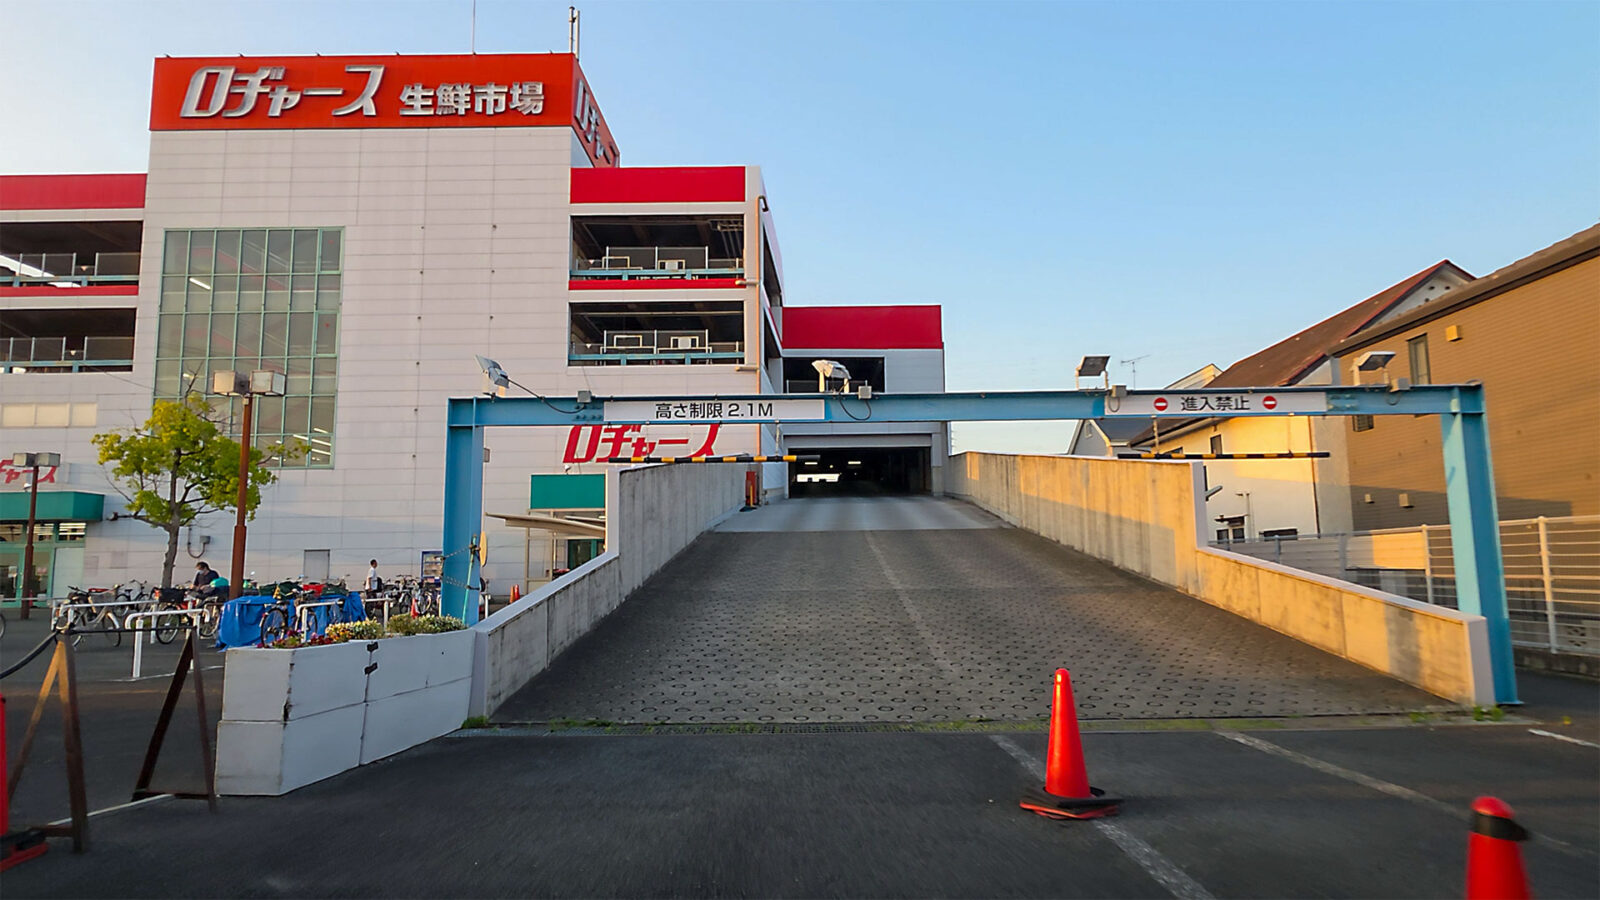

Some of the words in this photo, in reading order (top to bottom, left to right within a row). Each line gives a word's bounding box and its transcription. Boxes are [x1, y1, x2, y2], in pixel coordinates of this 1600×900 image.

[180, 65, 385, 117] ロヂャース
[400, 82, 544, 115] 生鮮市場
[1181, 396, 1251, 411] 進入禁止
